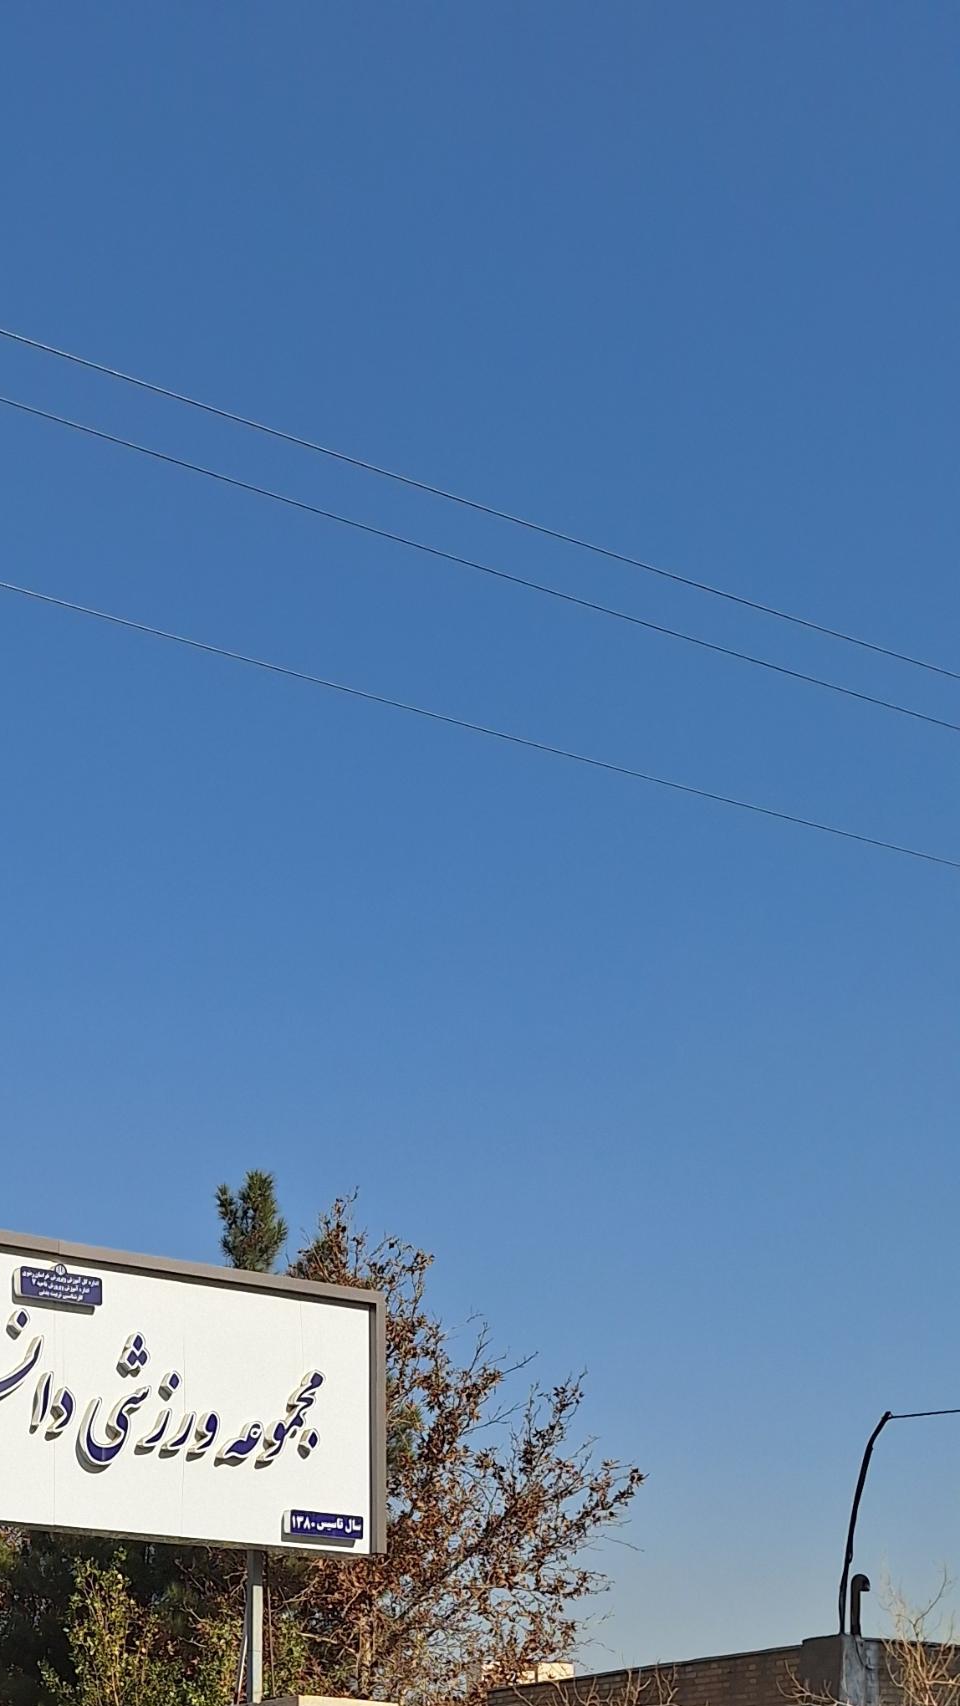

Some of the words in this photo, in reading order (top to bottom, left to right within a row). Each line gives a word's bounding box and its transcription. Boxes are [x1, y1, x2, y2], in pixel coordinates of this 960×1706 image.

[80, 1333, 219, 1469] ورزشی
[215, 1370, 324, 1464] مجموعه
[292, 1515, 315, 1530] ۱۳۸۰
[317, 1518, 344, 1531] تاسیس
[345, 1518, 362, 1533] سال
